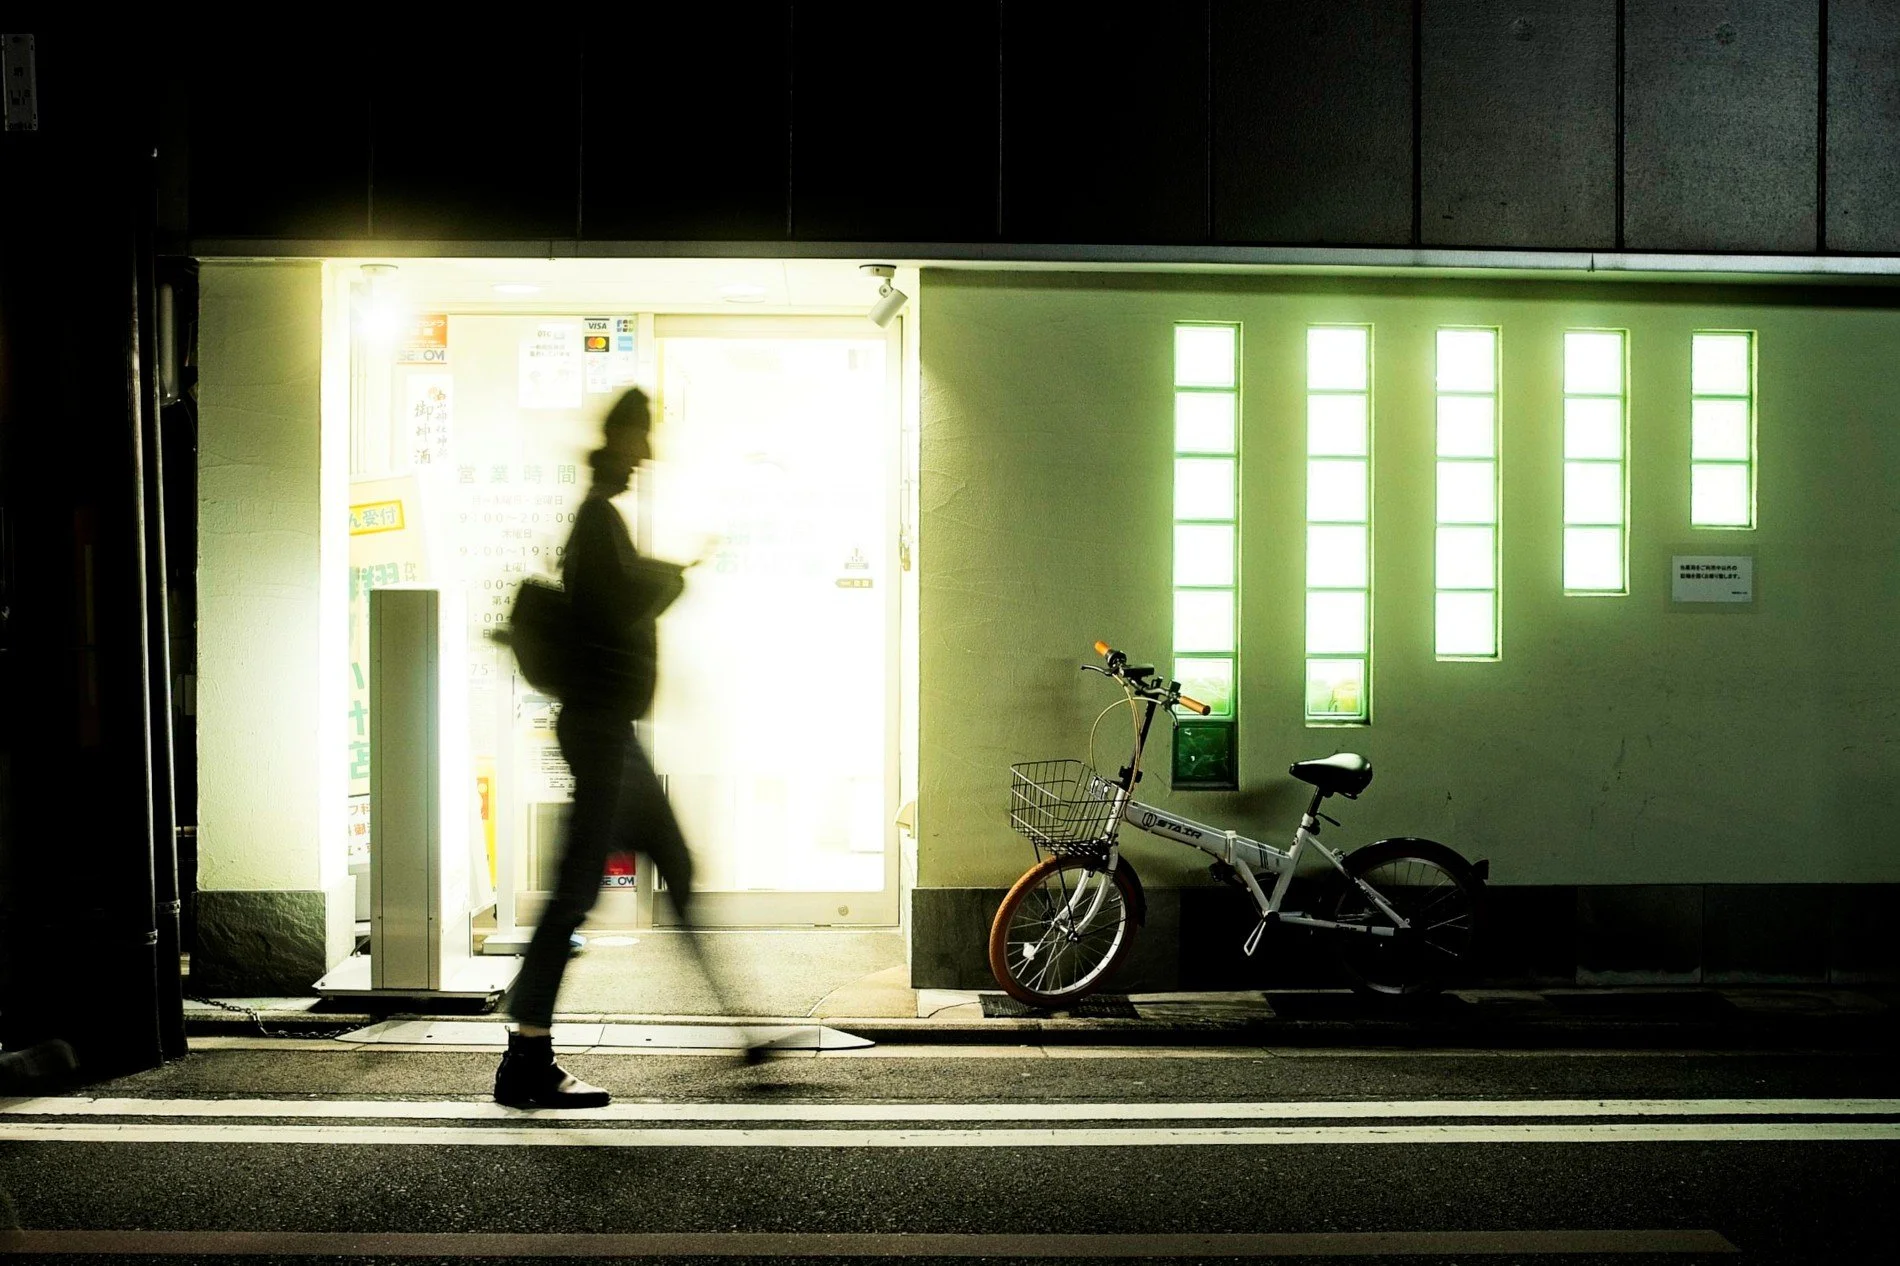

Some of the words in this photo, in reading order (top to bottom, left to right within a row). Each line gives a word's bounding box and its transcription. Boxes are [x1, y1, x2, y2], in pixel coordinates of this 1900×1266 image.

[588, 322, 607, 330] VISA
[398, 349, 444, 361] SEOM
[456, 463, 577, 485] 営業時間
[1156, 819, 1202, 839] STAIR
[600, 876, 634, 886] SEOM
